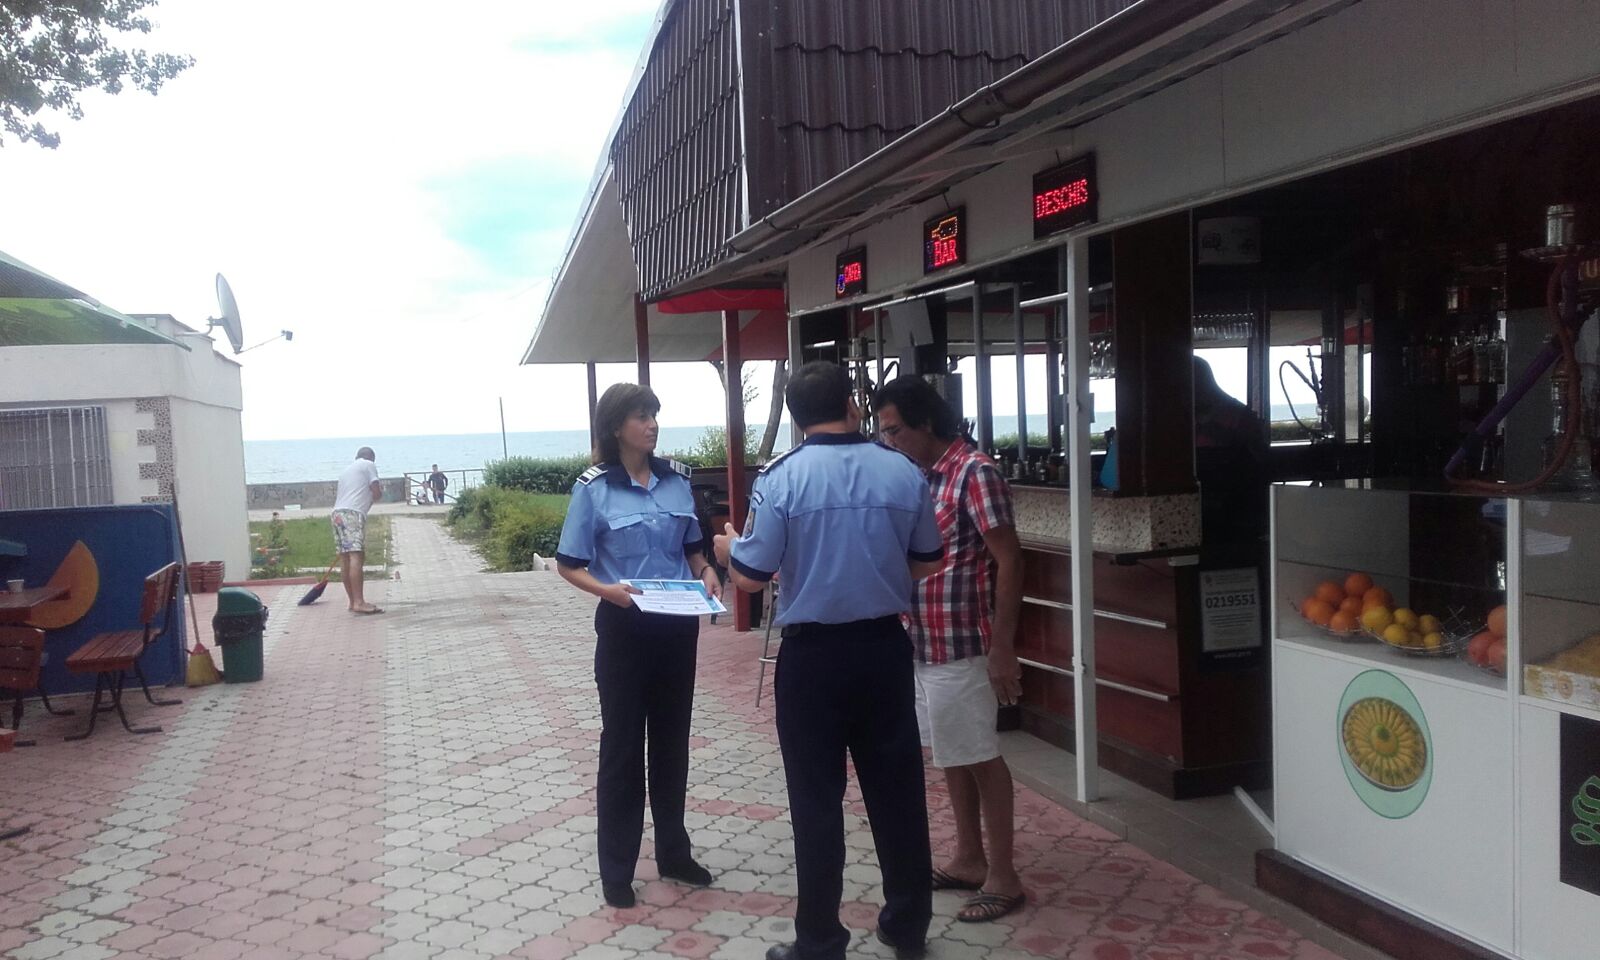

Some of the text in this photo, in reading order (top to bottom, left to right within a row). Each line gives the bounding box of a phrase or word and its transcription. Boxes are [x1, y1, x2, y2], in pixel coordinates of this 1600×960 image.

[1036, 178, 1088, 218] DESCHIS
[934, 239, 957, 266] BAR
[1205, 593, 1256, 609] 0219551
